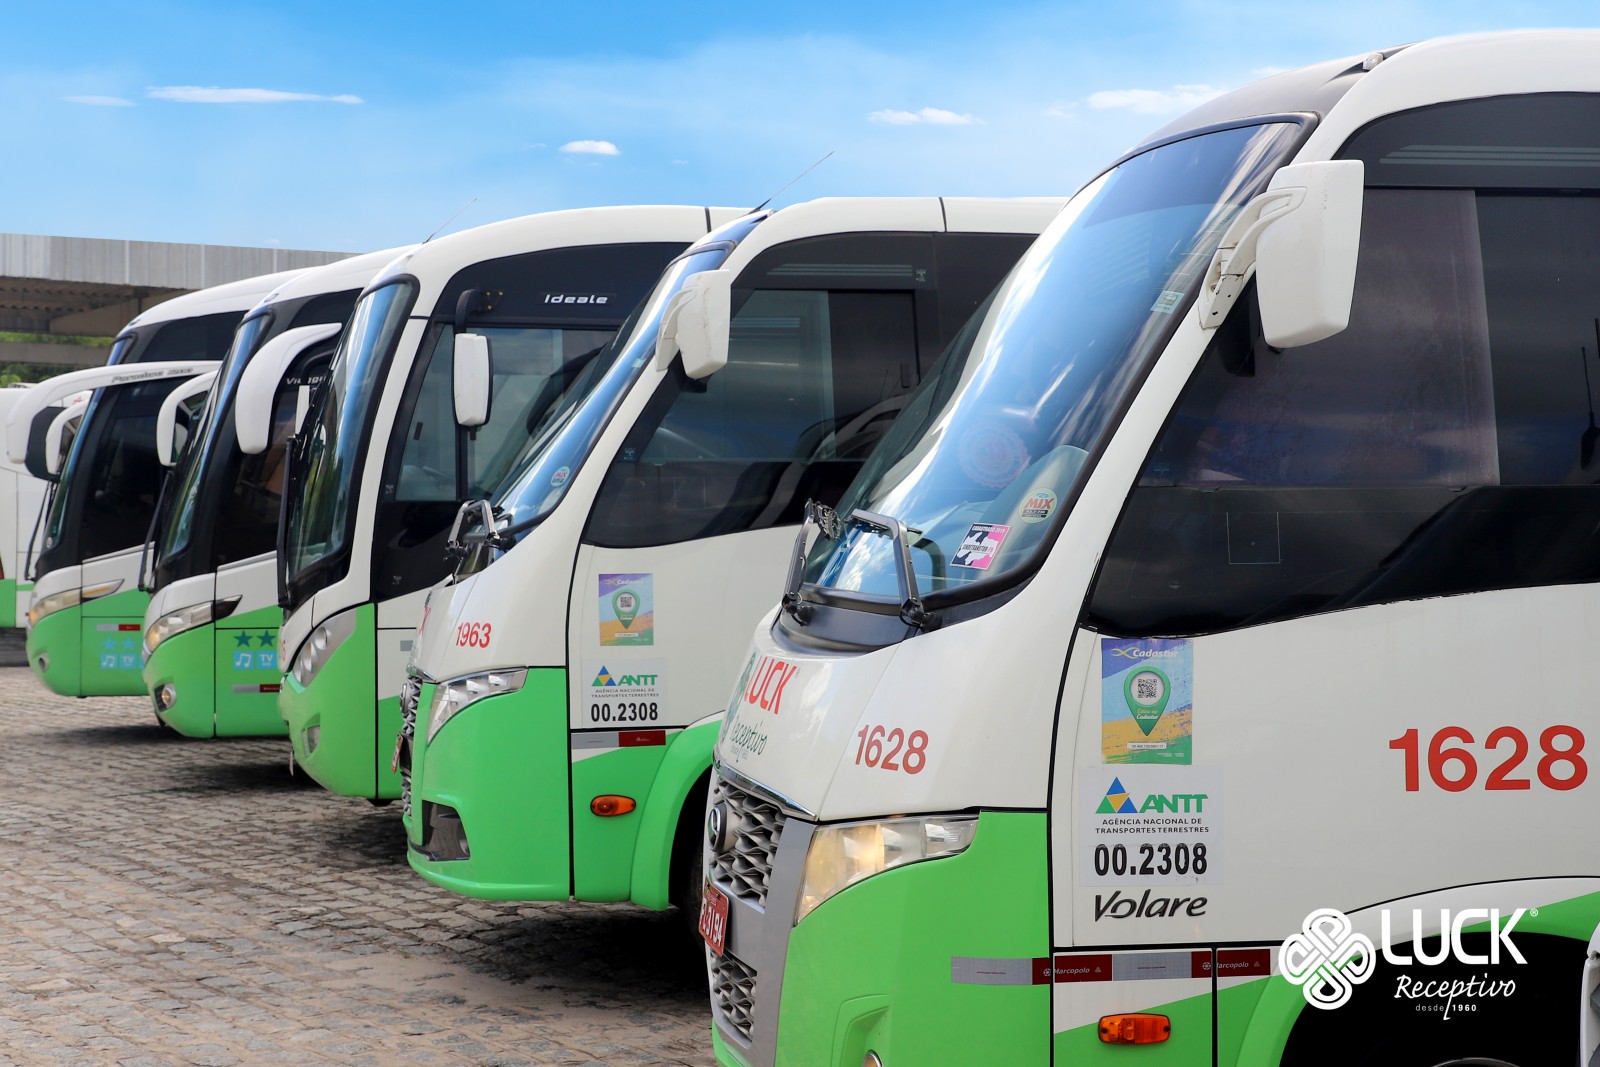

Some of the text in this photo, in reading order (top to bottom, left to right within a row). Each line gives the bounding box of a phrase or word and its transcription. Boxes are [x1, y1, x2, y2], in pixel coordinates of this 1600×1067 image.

[544, 294, 608, 304] Ideale
[1024, 497, 1055, 509] MIX
[456, 621, 492, 649] 1963
[1132, 648, 1179, 658] Cadastur
[617, 674, 658, 686] ANTT
[590, 702, 658, 722] 00.2308
[855, 724, 929, 775] 1628
[1388, 724, 1588, 793] 1628
[1138, 793, 1208, 814] ANTT
[1102, 817, 1141, 825] AGÊNCIA
[1094, 843, 1208, 876] 00.2308
[1094, 889, 1208, 922] Volare
[1053, 966, 1091, 975] Marcopolo
